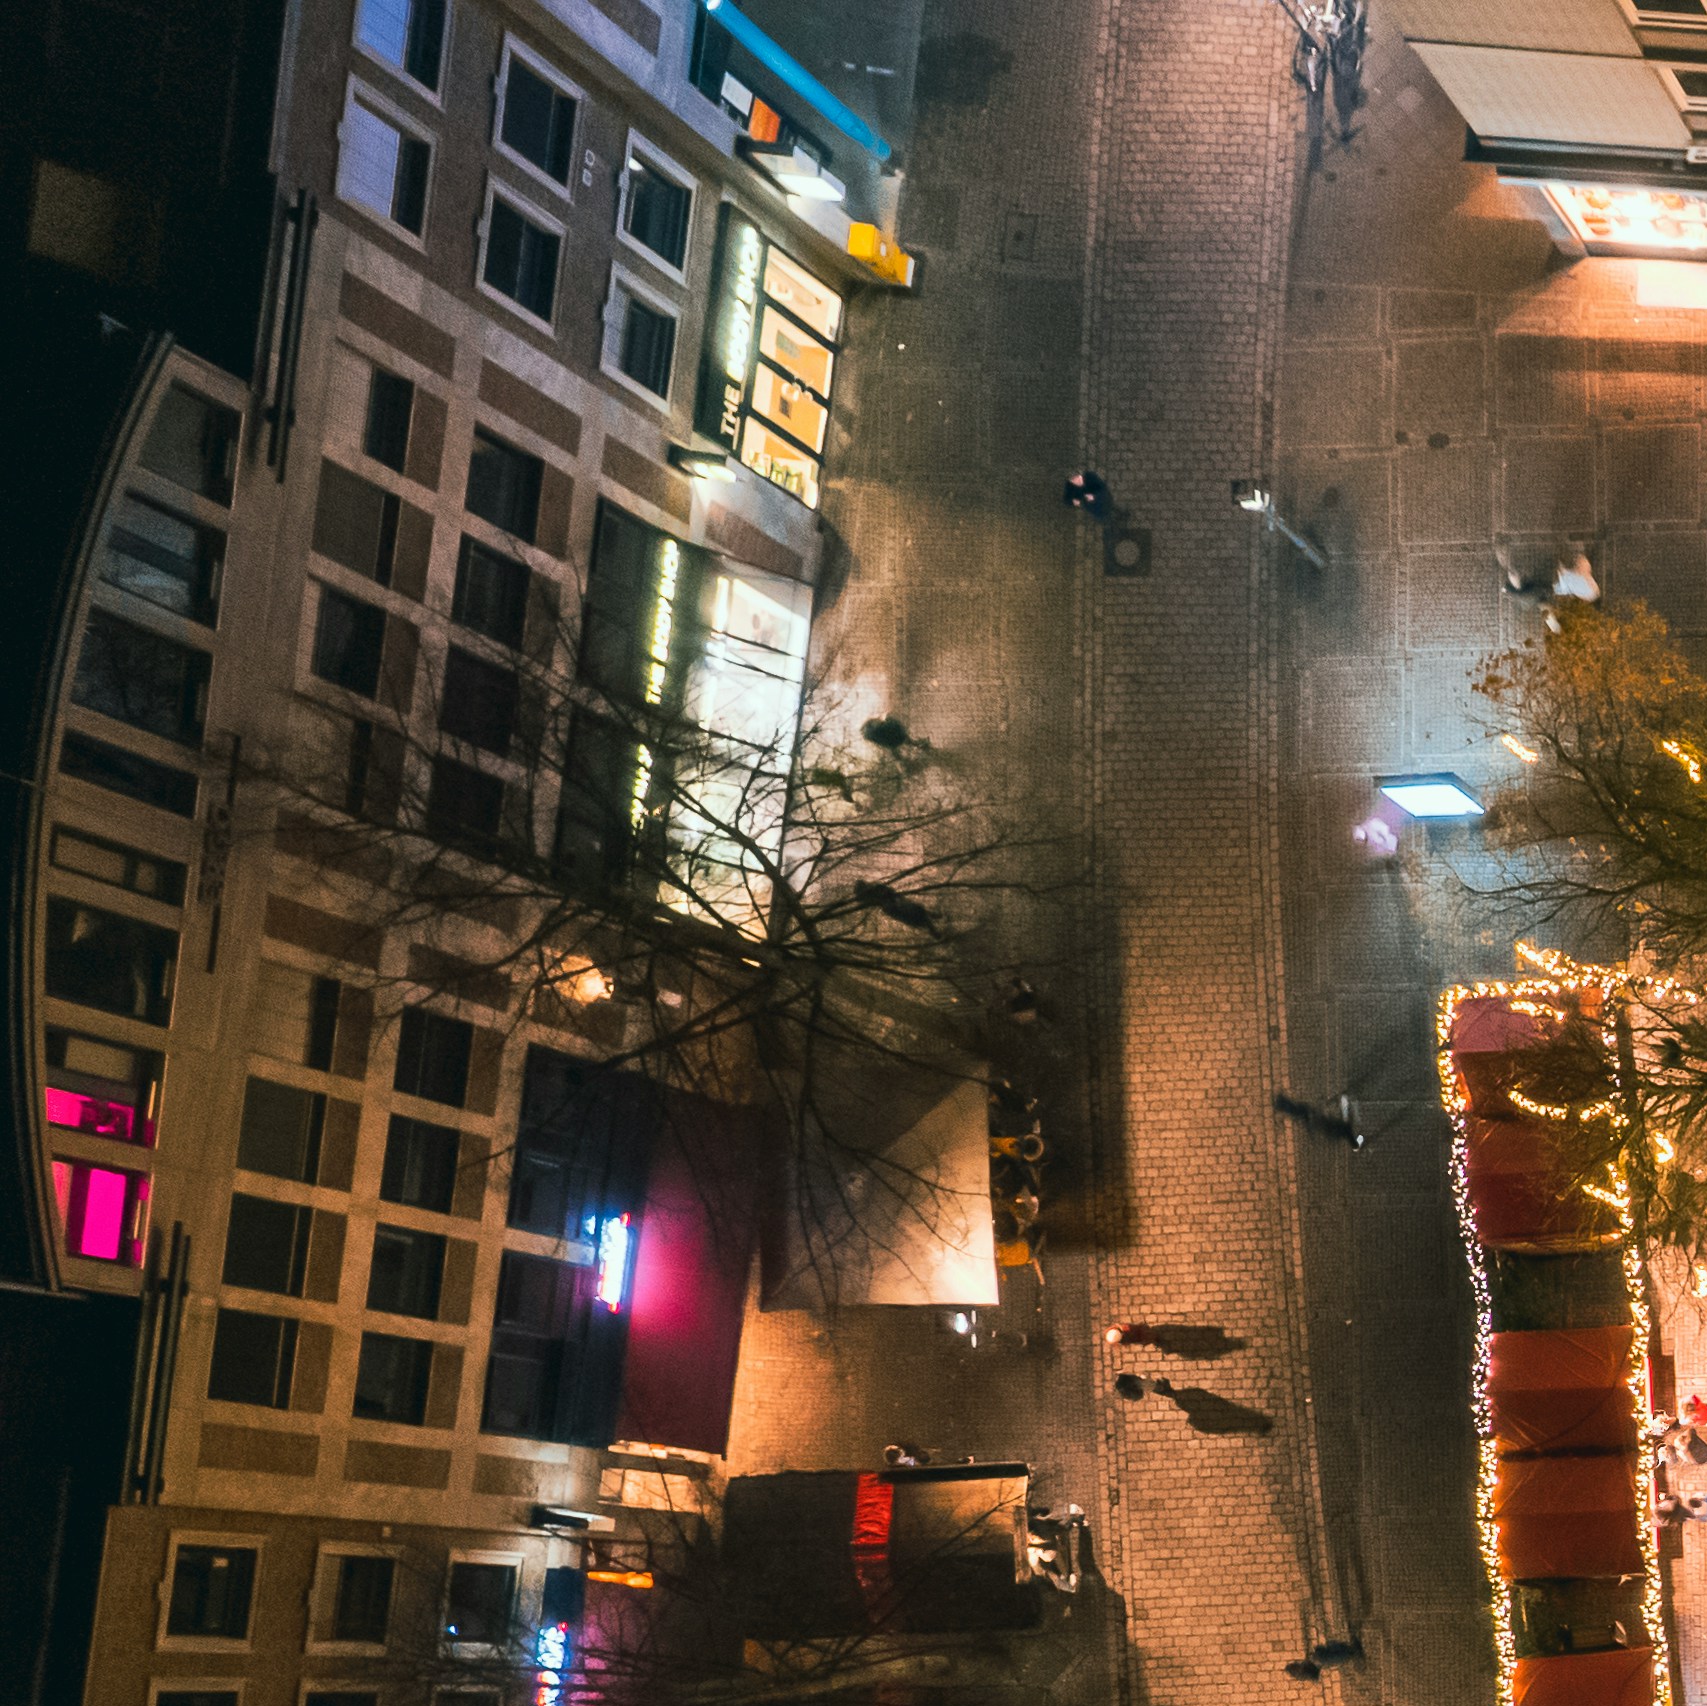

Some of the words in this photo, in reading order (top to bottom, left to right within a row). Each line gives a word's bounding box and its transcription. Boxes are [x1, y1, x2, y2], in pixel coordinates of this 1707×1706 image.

[735, 225, 762, 305] SHOP
[726, 299, 752, 384] BODY
[720, 383, 741, 437] THE
[657, 539, 680, 601] SHOP
